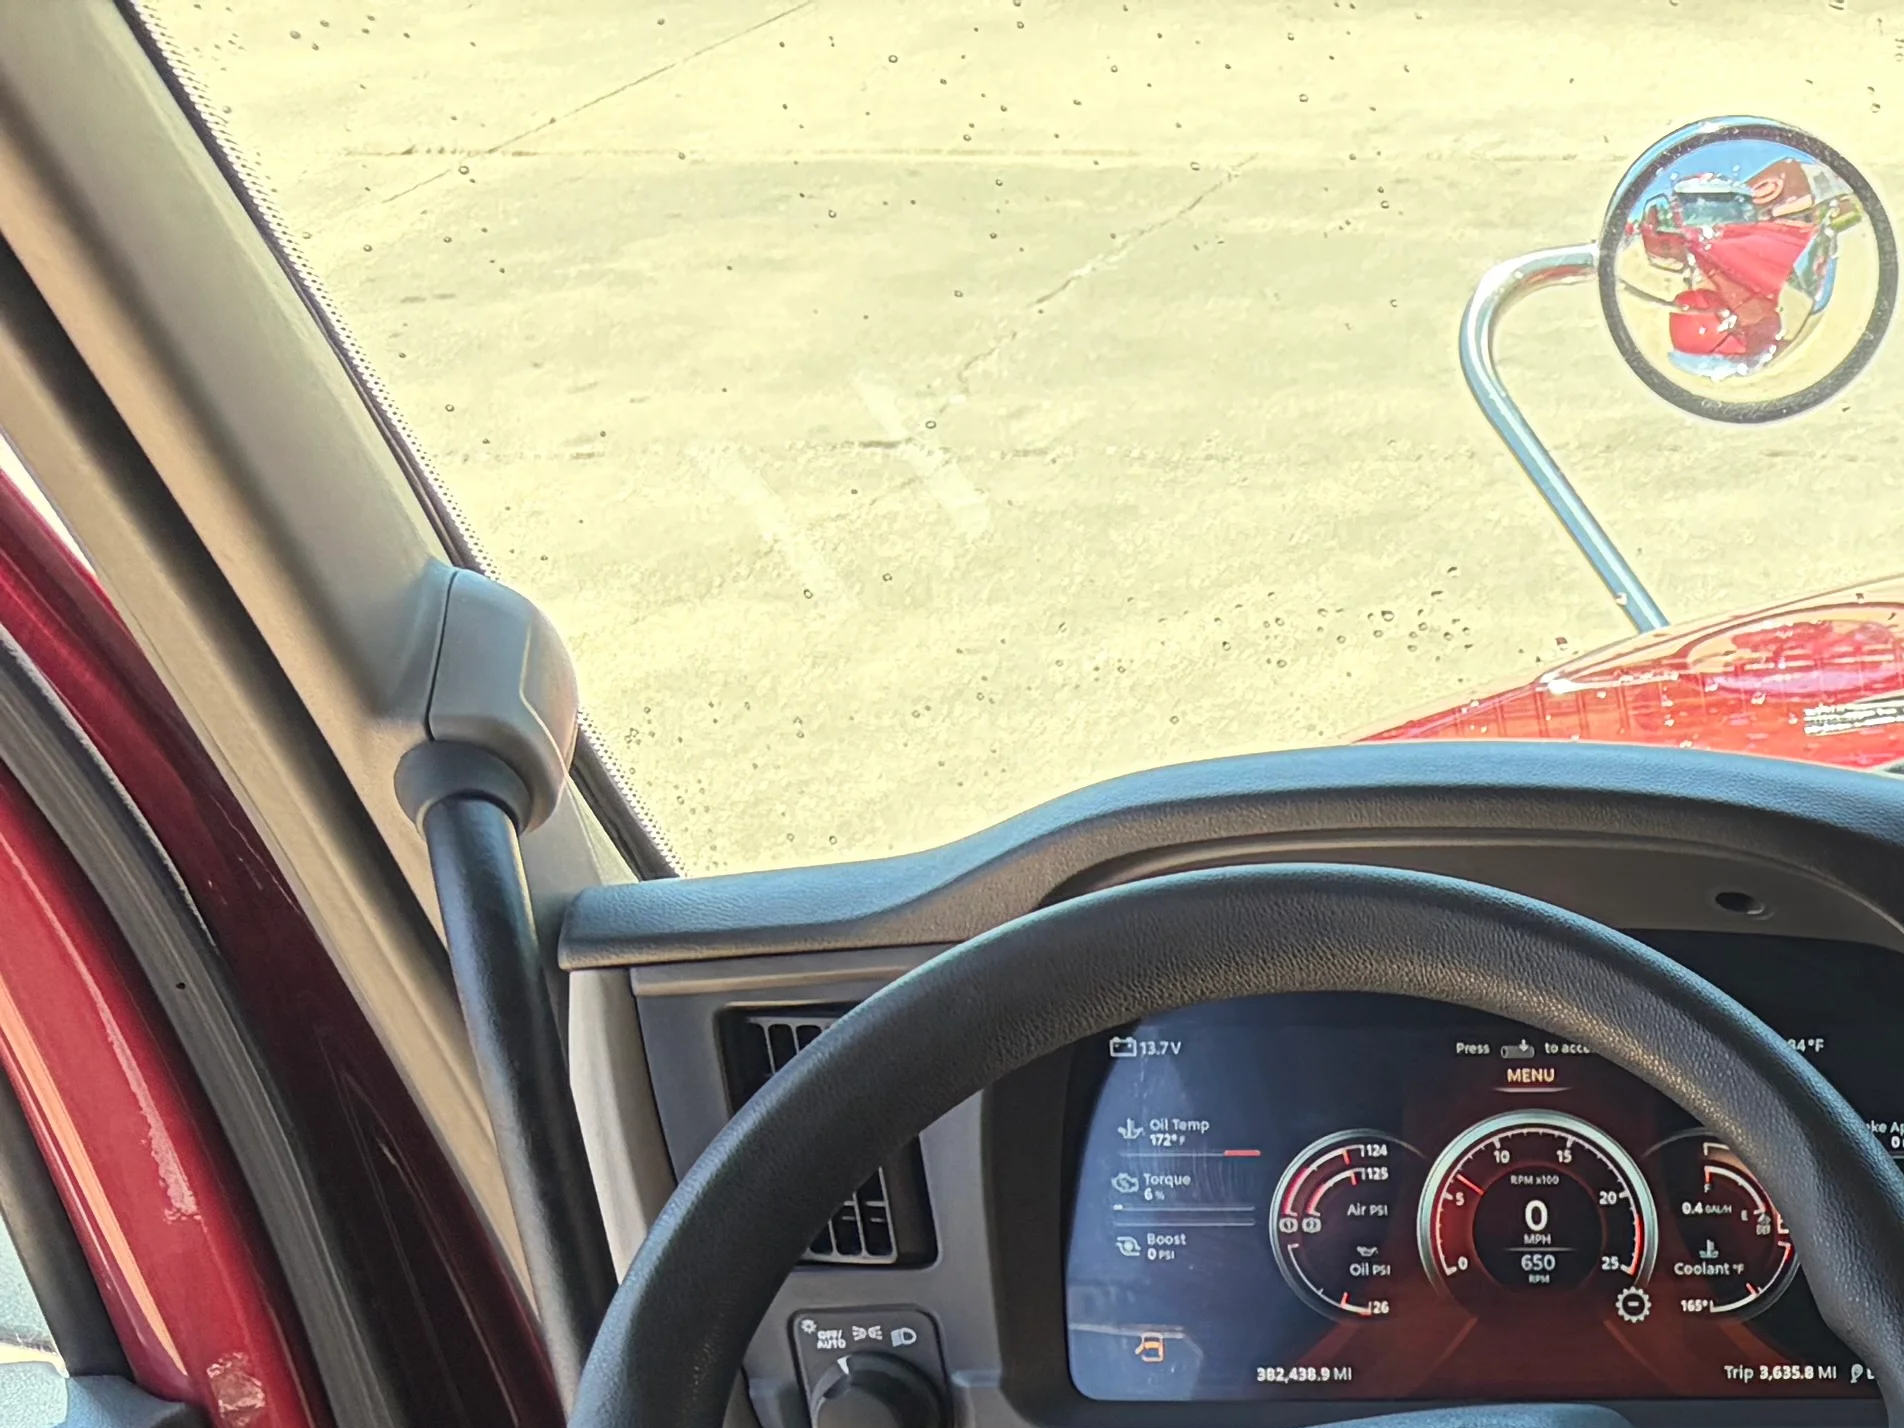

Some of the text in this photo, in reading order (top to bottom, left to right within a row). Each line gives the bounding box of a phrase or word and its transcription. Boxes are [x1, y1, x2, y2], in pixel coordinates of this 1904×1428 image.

[1456, 1042, 1490, 1056] Press
[1544, 1042, 1558, 1054] to
[1507, 1068, 1555, 1083] MENU
[1150, 1118, 1210, 1134] Oil Temp
[1891, 1136, 1900, 1148] 0
[1366, 1144, 1388, 1157] 124
[1494, 1150, 1510, 1163] 10
[1557, 1150, 1572, 1163] 15
[1367, 1167, 1388, 1180] 125
[1510, 1175, 1559, 1185] RPM x100
[1143, 1173, 1191, 1188] Torque
[1144, 1188, 1153, 1200] 6
[1455, 1193, 1465, 1206] 5
[1599, 1191, 1617, 1205] 20
[1347, 1204, 1388, 1216] Air PSI
[1682, 1202, 1703, 1215] 0.4
[1524, 1200, 1548, 1231] 0
[1147, 1233, 1186, 1246] Boost
[1524, 1234, 1551, 1245] MPH
[1148, 1249, 1175, 1260] 0 PSI
[1458, 1257, 1468, 1270] 0
[1521, 1254, 1556, 1271] 650
[1602, 1257, 1619, 1270] 25
[1674, 1263, 1730, 1275] Coolant
[1349, 1264, 1391, 1276] Oil PSI
[1528, 1275, 1550, 1284] RPM
[1333, 1367, 1352, 1381] MI
[1724, 1365, 1754, 1383] Trip
[1818, 1366, 1837, 1379] MI
